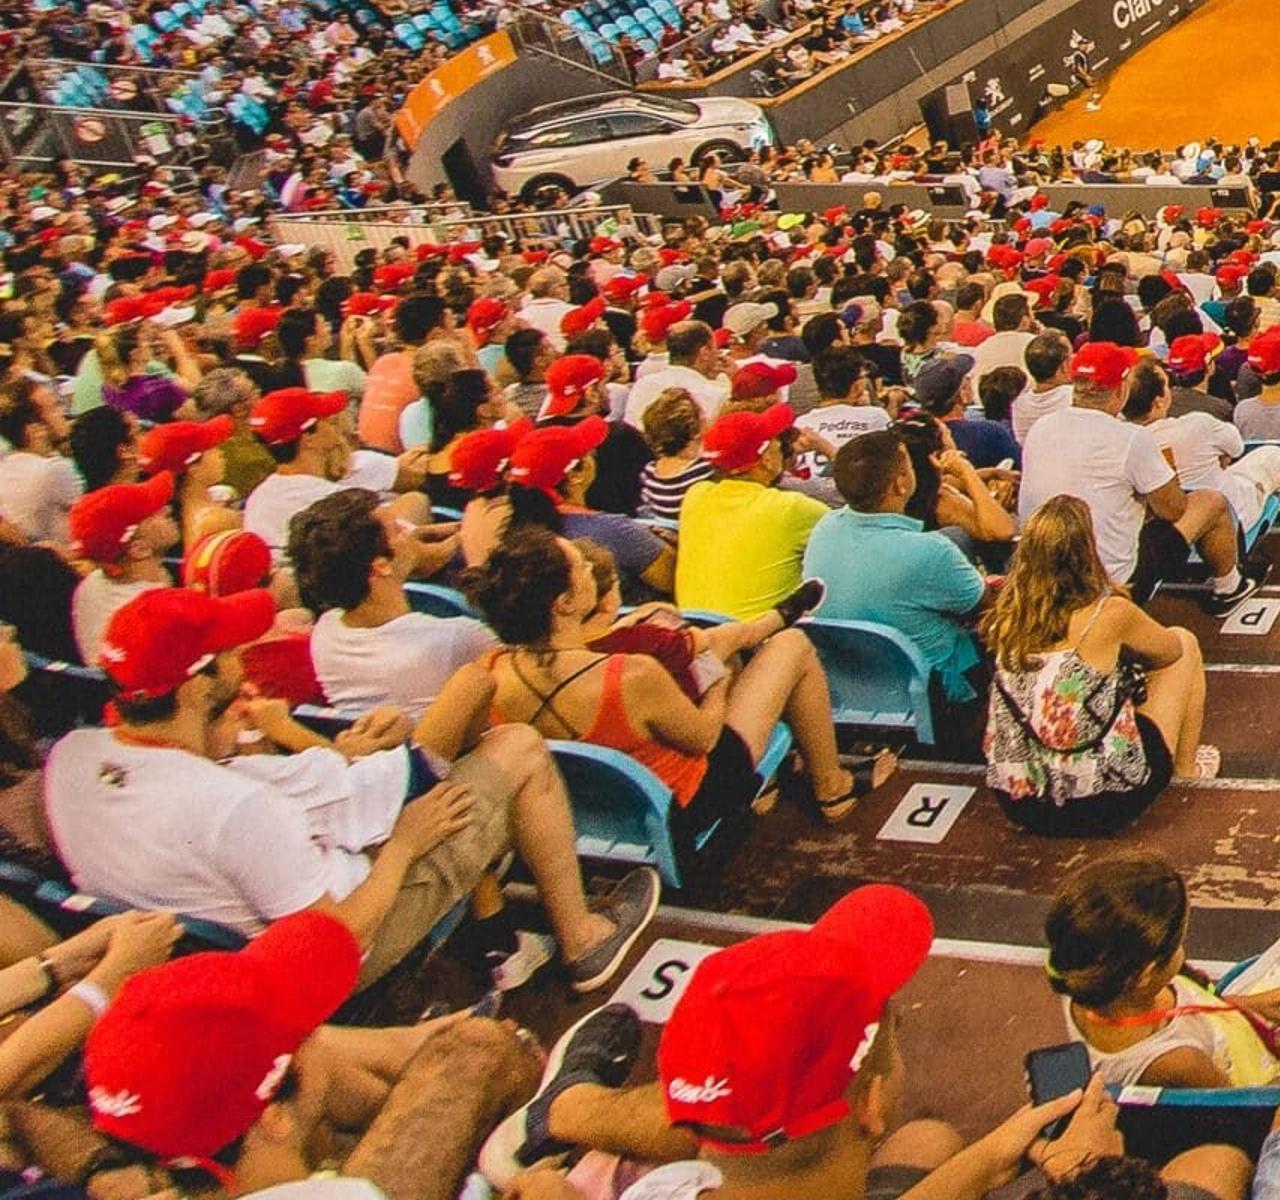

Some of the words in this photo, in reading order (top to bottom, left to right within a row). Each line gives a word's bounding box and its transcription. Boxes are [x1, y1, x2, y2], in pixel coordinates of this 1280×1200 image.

[818, 419, 870, 433] Pedras
[1240, 606, 1268, 626] P
[907, 796, 951, 828] R
[640, 959, 691, 1000] S
